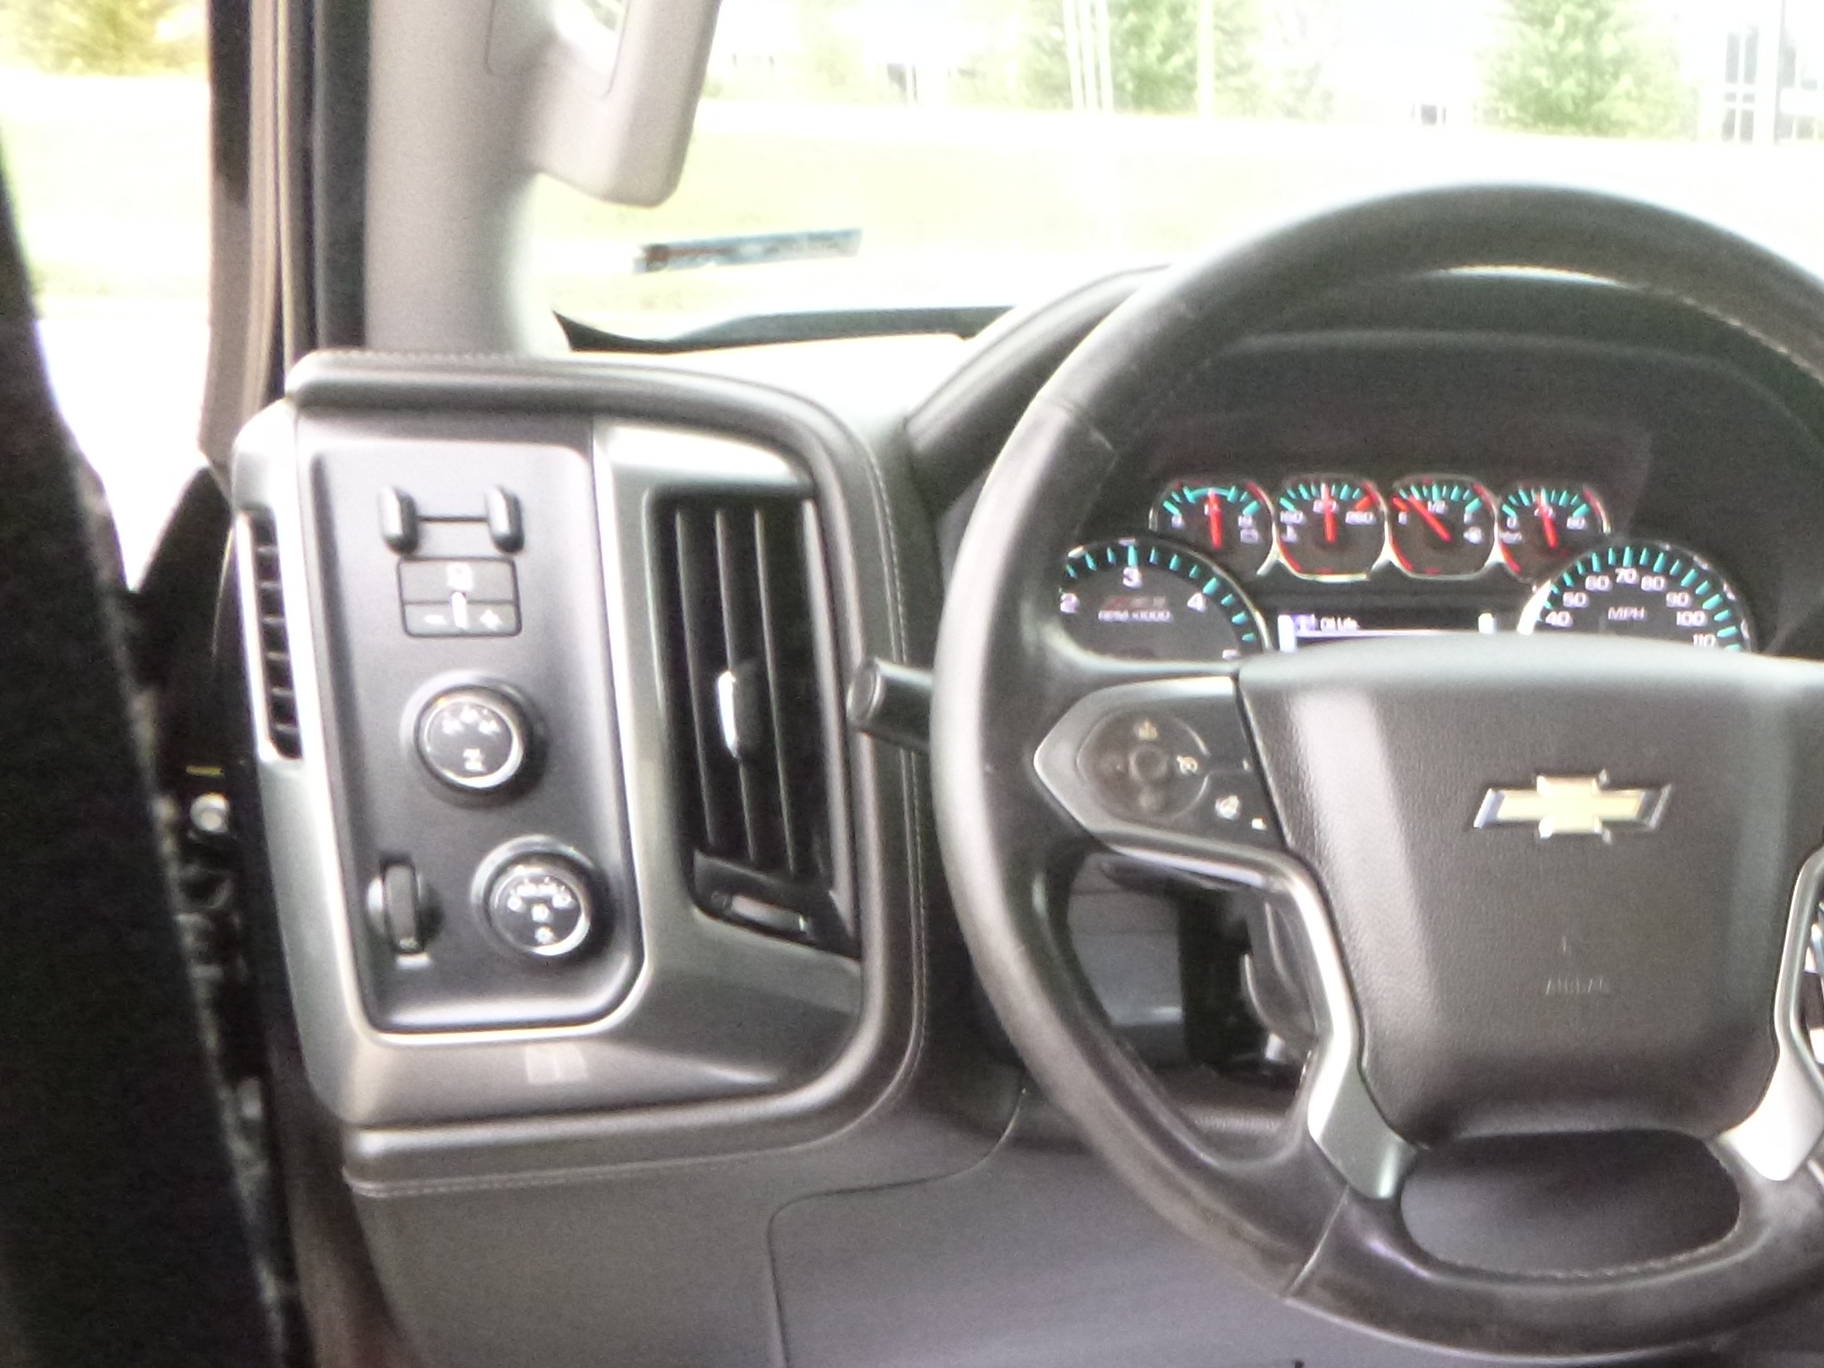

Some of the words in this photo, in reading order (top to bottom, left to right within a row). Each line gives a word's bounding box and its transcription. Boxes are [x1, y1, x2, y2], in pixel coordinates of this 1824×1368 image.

[1122, 567, 1142, 589] 3
[1615, 568, 1637, 584] 70
[1059, 593, 1080, 614] 2
[1187, 593, 1208, 613] 4
[1666, 592, 1690, 608] 90
[1545, 611, 1571, 627] 40
[1608, 607, 1645, 621] MPH
[1676, 611, 1706, 627] 100
[1692, 634, 1717, 647] 110
